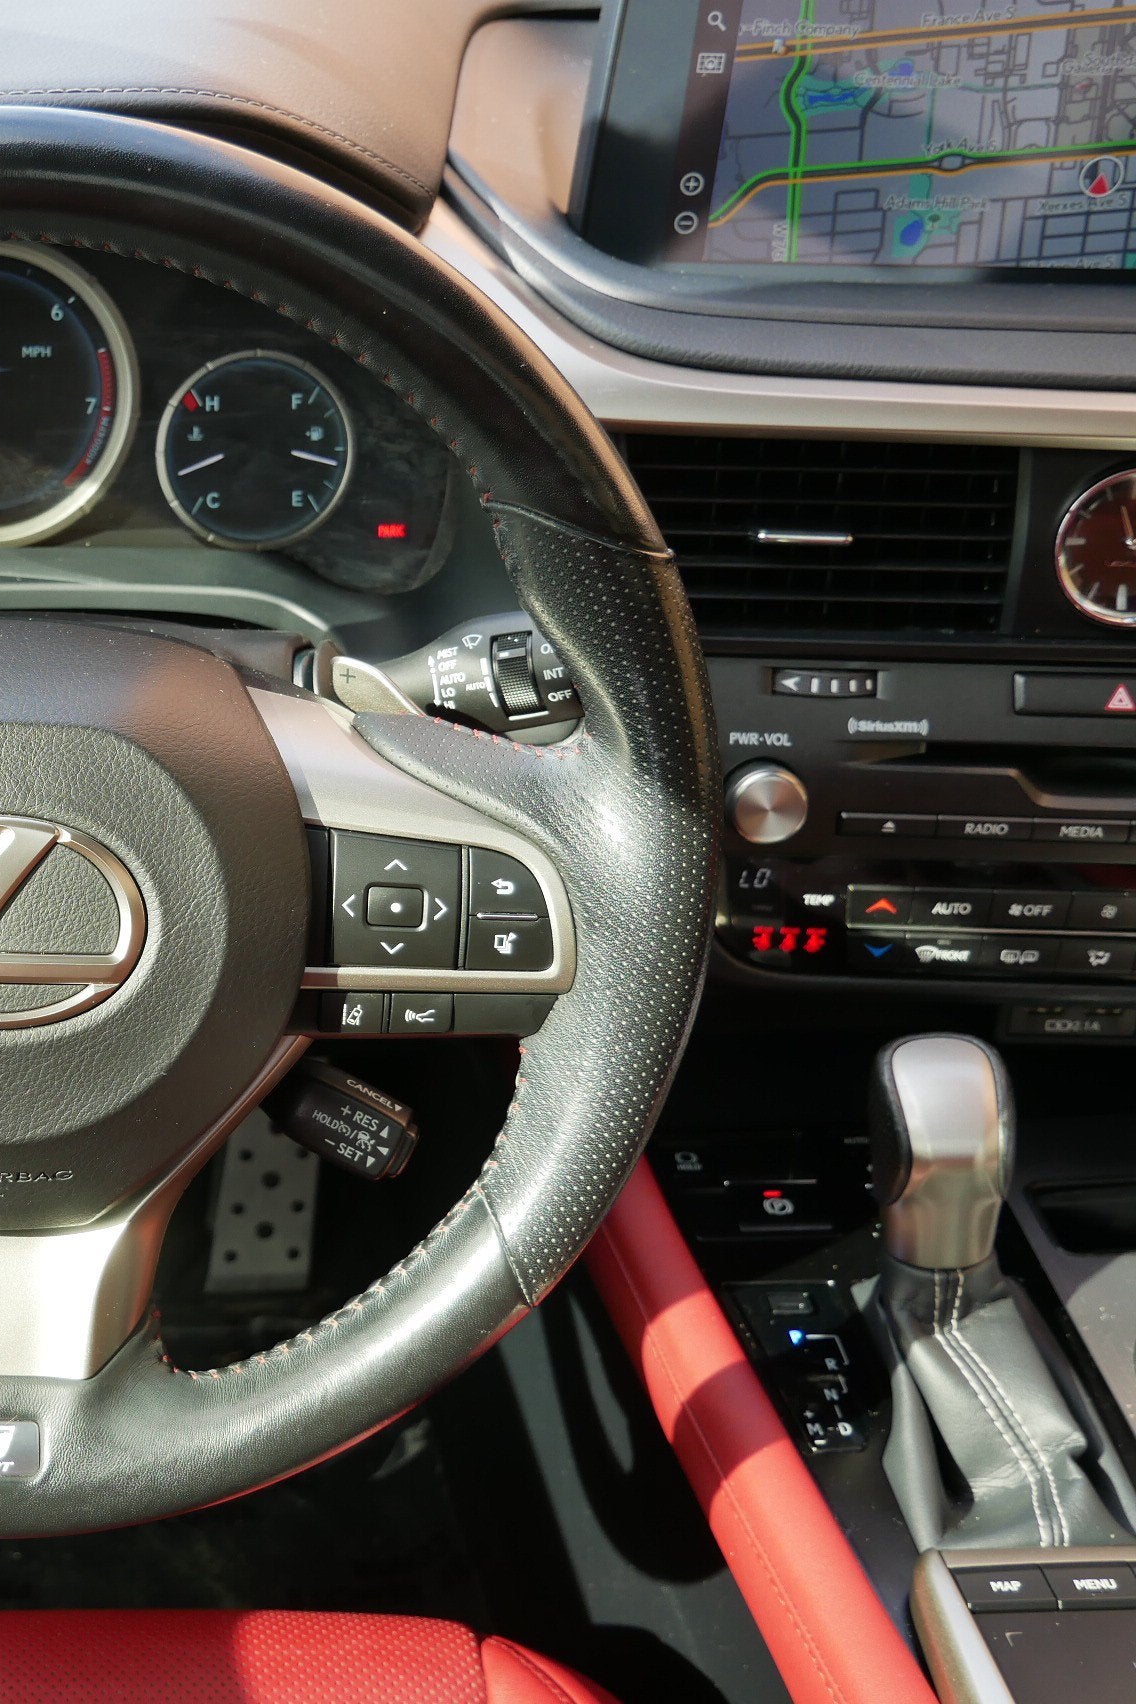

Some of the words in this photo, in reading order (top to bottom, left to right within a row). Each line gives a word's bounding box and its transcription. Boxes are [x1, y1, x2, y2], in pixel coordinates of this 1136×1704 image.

[920, 13, 970, 28] France
[973, 9, 1002, 22] Ave
[795, 20, 861, 39] Company
[853, 70, 925, 88] Centennial
[883, 194, 931, 210] Adams
[50, 303, 63, 321] 6
[21, 346, 53, 358] MPH
[85, 396, 98, 415] 7
[205, 395, 219, 411] H
[291, 395, 302, 410] F
[205, 492, 220, 509] C
[292, 493, 303, 508] E
[378, 523, 407, 538] PARK
[437, 646, 458, 659] MIST
[438, 660, 457, 672] OFF
[440, 672, 465, 685] AUTO
[543, 667, 564, 681] INT
[441, 687, 455, 699] LO
[465, 681, 486, 691] AUTO
[547, 689, 572, 702] OFF
[964, 822, 1009, 836] RADIO
[1059, 825, 1105, 840] MEDIA
[802, 893, 835, 907] TEMP
[931, 901, 972, 915] AUTO
[1023, 903, 1054, 917] OFF
[346, 1078, 394, 1110] CANCEL
[312, 1109, 340, 1131] HOLD
[353, 1110, 379, 1132] RES
[337, 1142, 364, 1163] SET
[824, 1357, 839, 1371] R
[837, 1421, 854, 1437] D
[989, 1580, 1022, 1592] MAP
[1072, 1578, 1118, 1591] MENU
